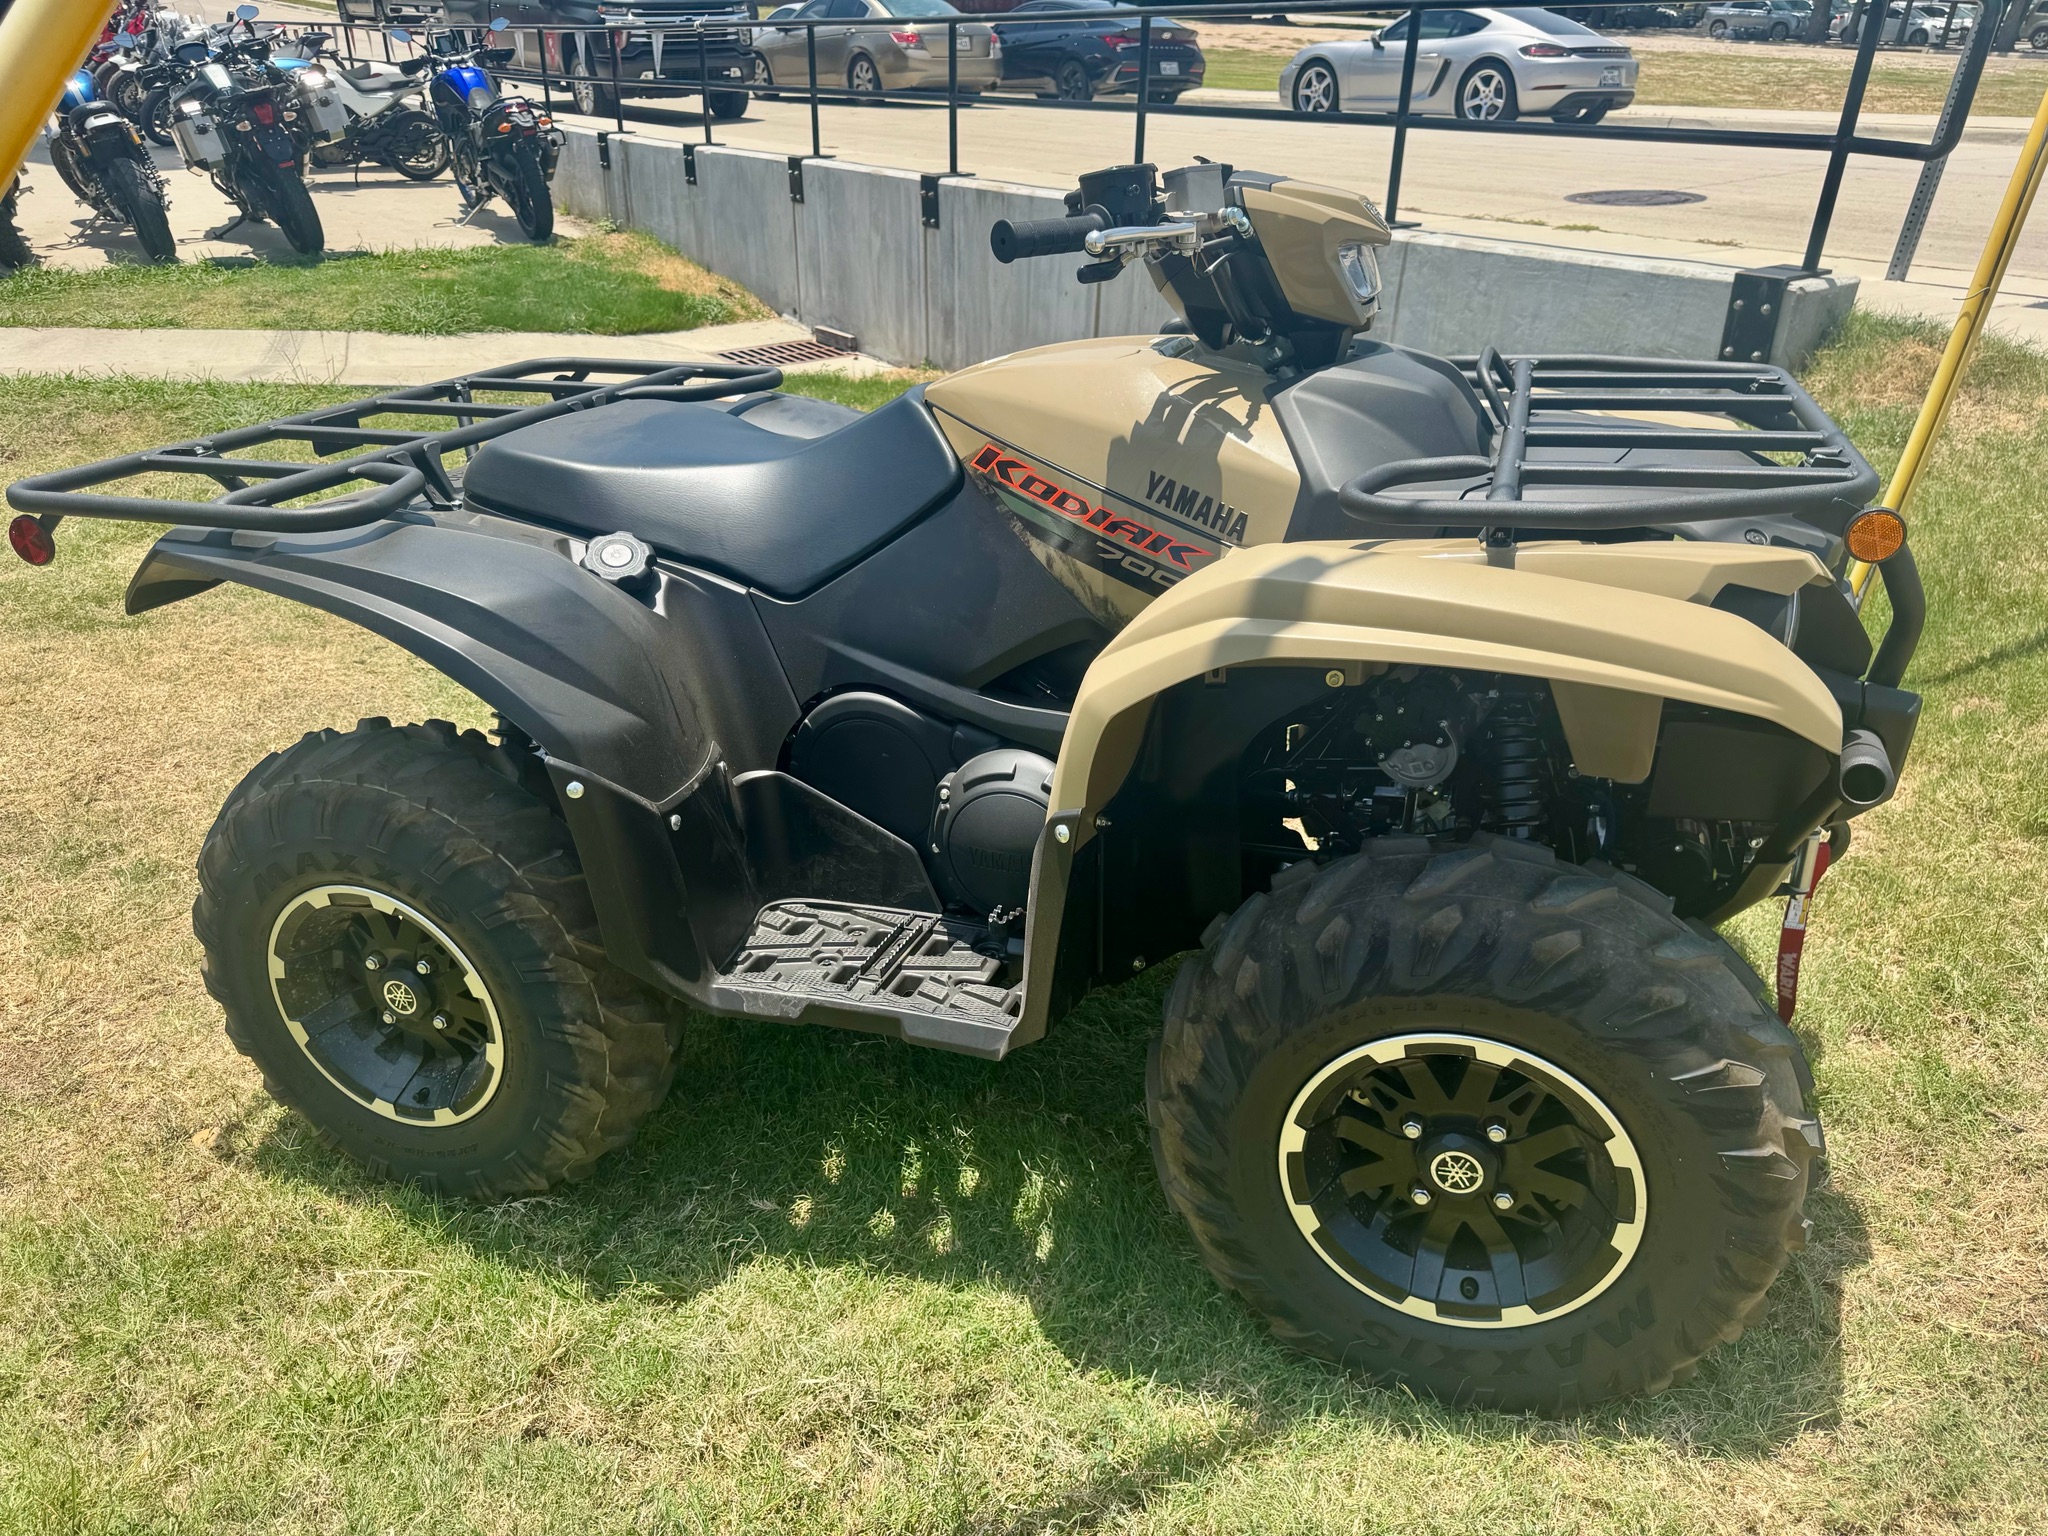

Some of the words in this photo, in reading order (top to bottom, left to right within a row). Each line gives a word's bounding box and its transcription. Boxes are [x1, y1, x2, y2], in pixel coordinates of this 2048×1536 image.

[970, 443, 1216, 571] KODIAK
[1145, 470, 1249, 542] YAMAHA
[252, 850, 460, 924] MAXXIS
[1779, 952, 1798, 1000] WARN
[1353, 1284, 1657, 1377] MAXXIS
